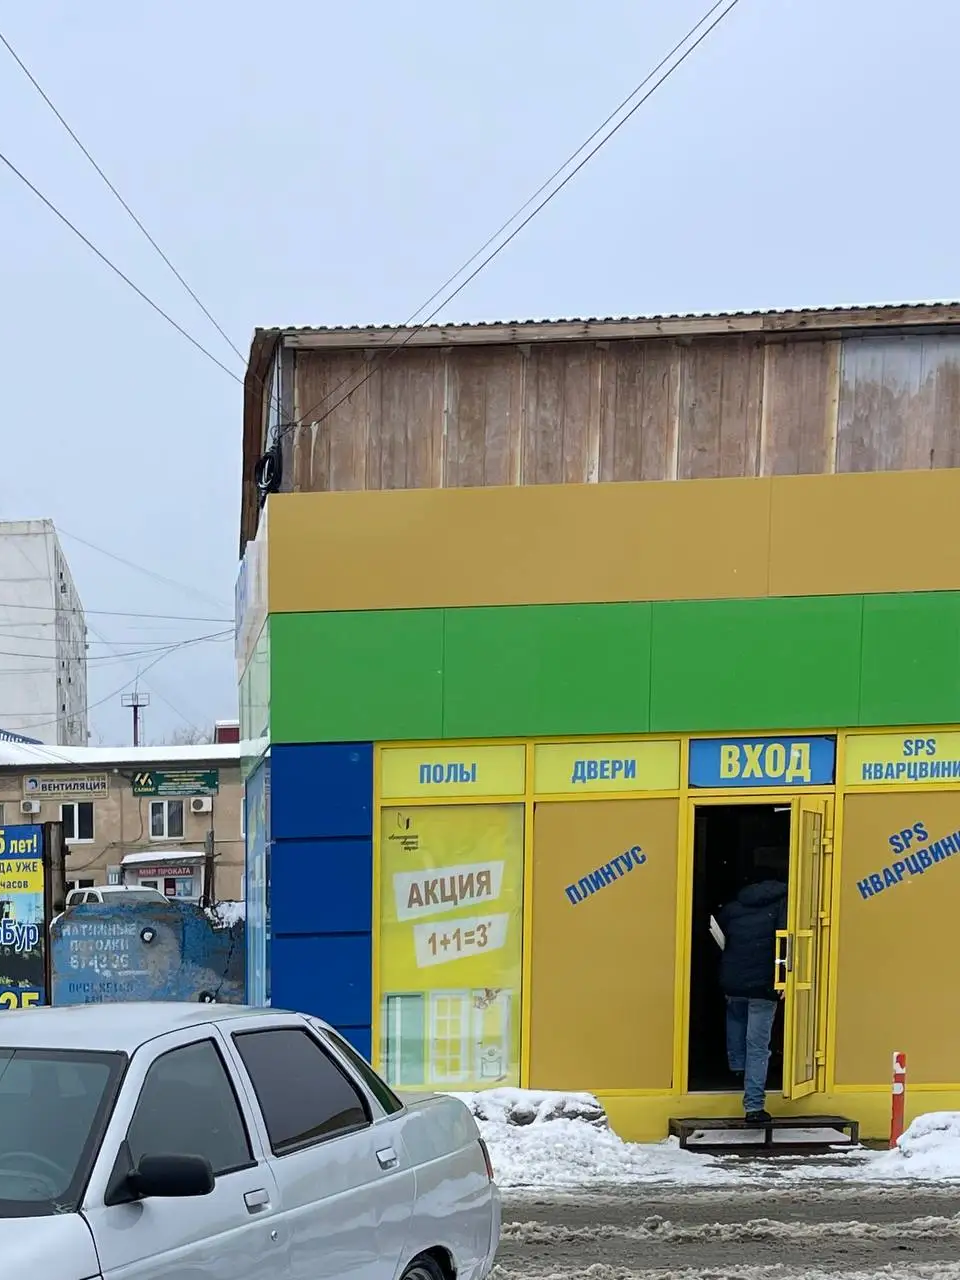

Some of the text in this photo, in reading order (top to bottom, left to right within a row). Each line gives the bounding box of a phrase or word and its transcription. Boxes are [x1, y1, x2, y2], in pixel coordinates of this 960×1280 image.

[902, 738, 937, 757] SPS
[572, 759, 637, 784] ДВЕРИ
[719, 742, 812, 783] ВХОД
[419, 763, 477, 784] ПОЛЫ
[41, 782, 106, 792] ВЕНТИЛЯЦИЯ
[9, 835, 37, 854] лет!
[888, 822, 929, 855] SPS
[16, 861, 38, 873] УЖЕ
[158, 867, 191, 876] ПРОКАТА
[564, 844, 647, 906] ПЛИНТУС
[0, 880, 29, 889] часов
[407, 870, 491, 909] АКЦИЯ
